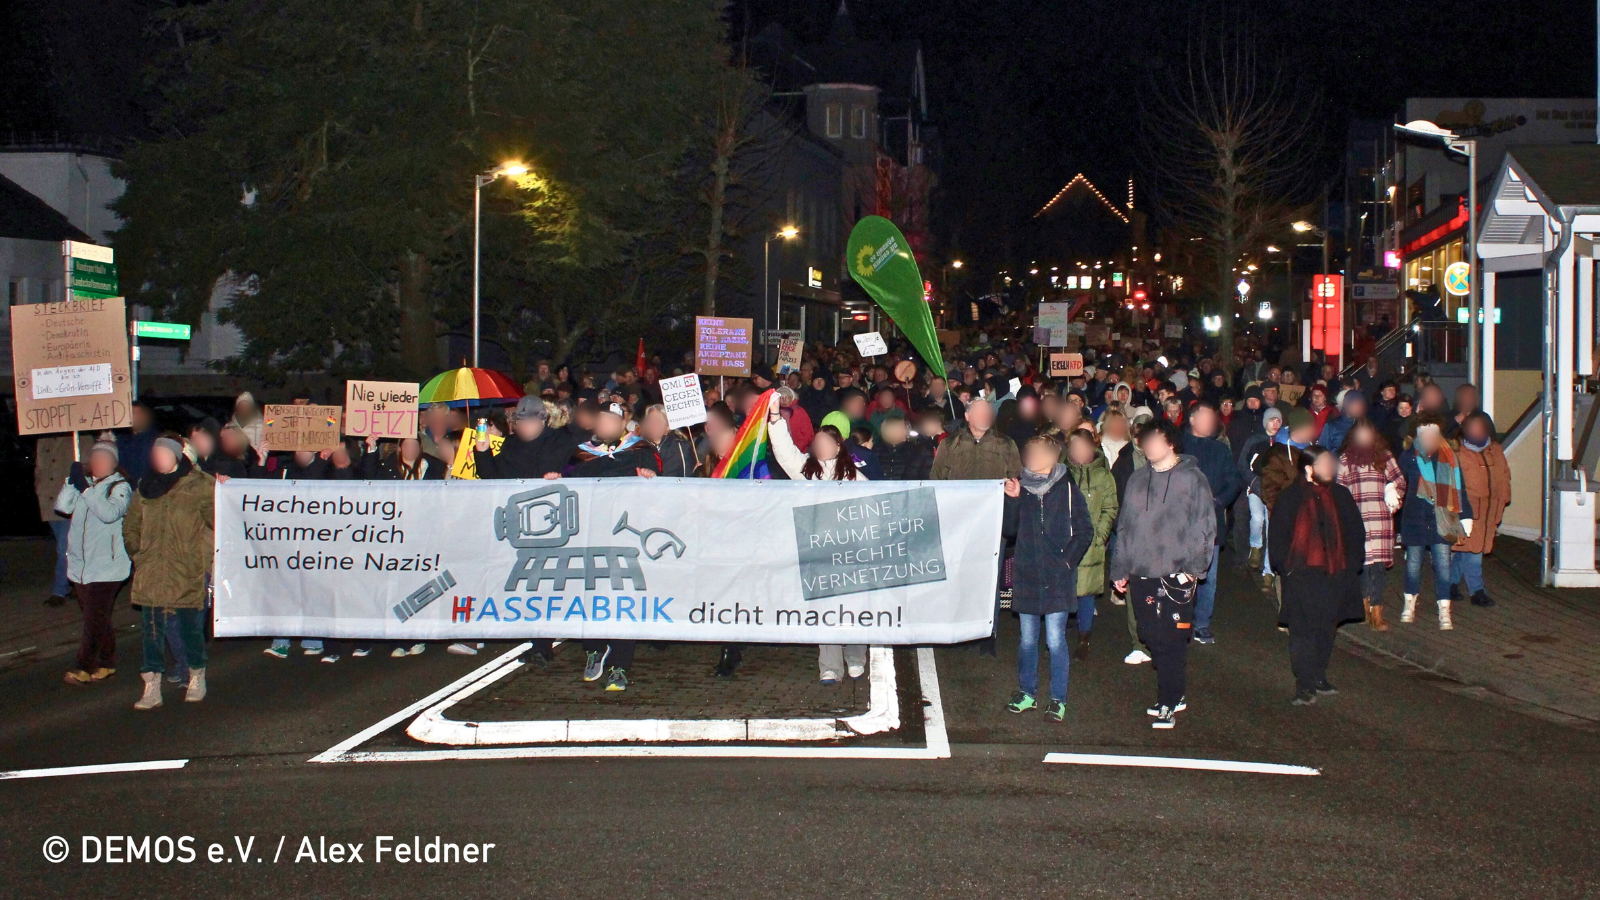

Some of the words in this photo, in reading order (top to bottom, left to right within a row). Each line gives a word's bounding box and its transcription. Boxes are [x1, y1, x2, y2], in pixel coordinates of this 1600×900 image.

[34, 299, 105, 314] STECKBRIEF
[46, 316, 85, 327] Deutsche
[700, 327, 746, 336] TOLERANZ
[46, 329, 89, 340] Demokratin
[56, 366, 75, 375] Augen
[352, 383, 374, 402] Nie
[380, 390, 418, 403] wieder
[266, 406, 335, 416] MENSCHENRECHTE
[373, 403, 386, 411] ist
[666, 399, 700, 412] RECHTS
[26, 403, 76, 430] STOPPT
[282, 417, 312, 428] STATT
[353, 409, 418, 435] JETZT
[242, 494, 403, 520] Hachenburg,
[837, 500, 891, 522] KEINE
[810, 524, 880, 549] RÄUME
[888, 517, 925, 537] FÜR
[245, 554, 279, 569] um
[287, 551, 354, 570] deine
[364, 553, 440, 572] Nazis!
[832, 542, 907, 566] RECHTE
[804, 558, 940, 592] VERNETZUNG
[688, 601, 763, 625] dicht
[776, 604, 903, 628] machen!
